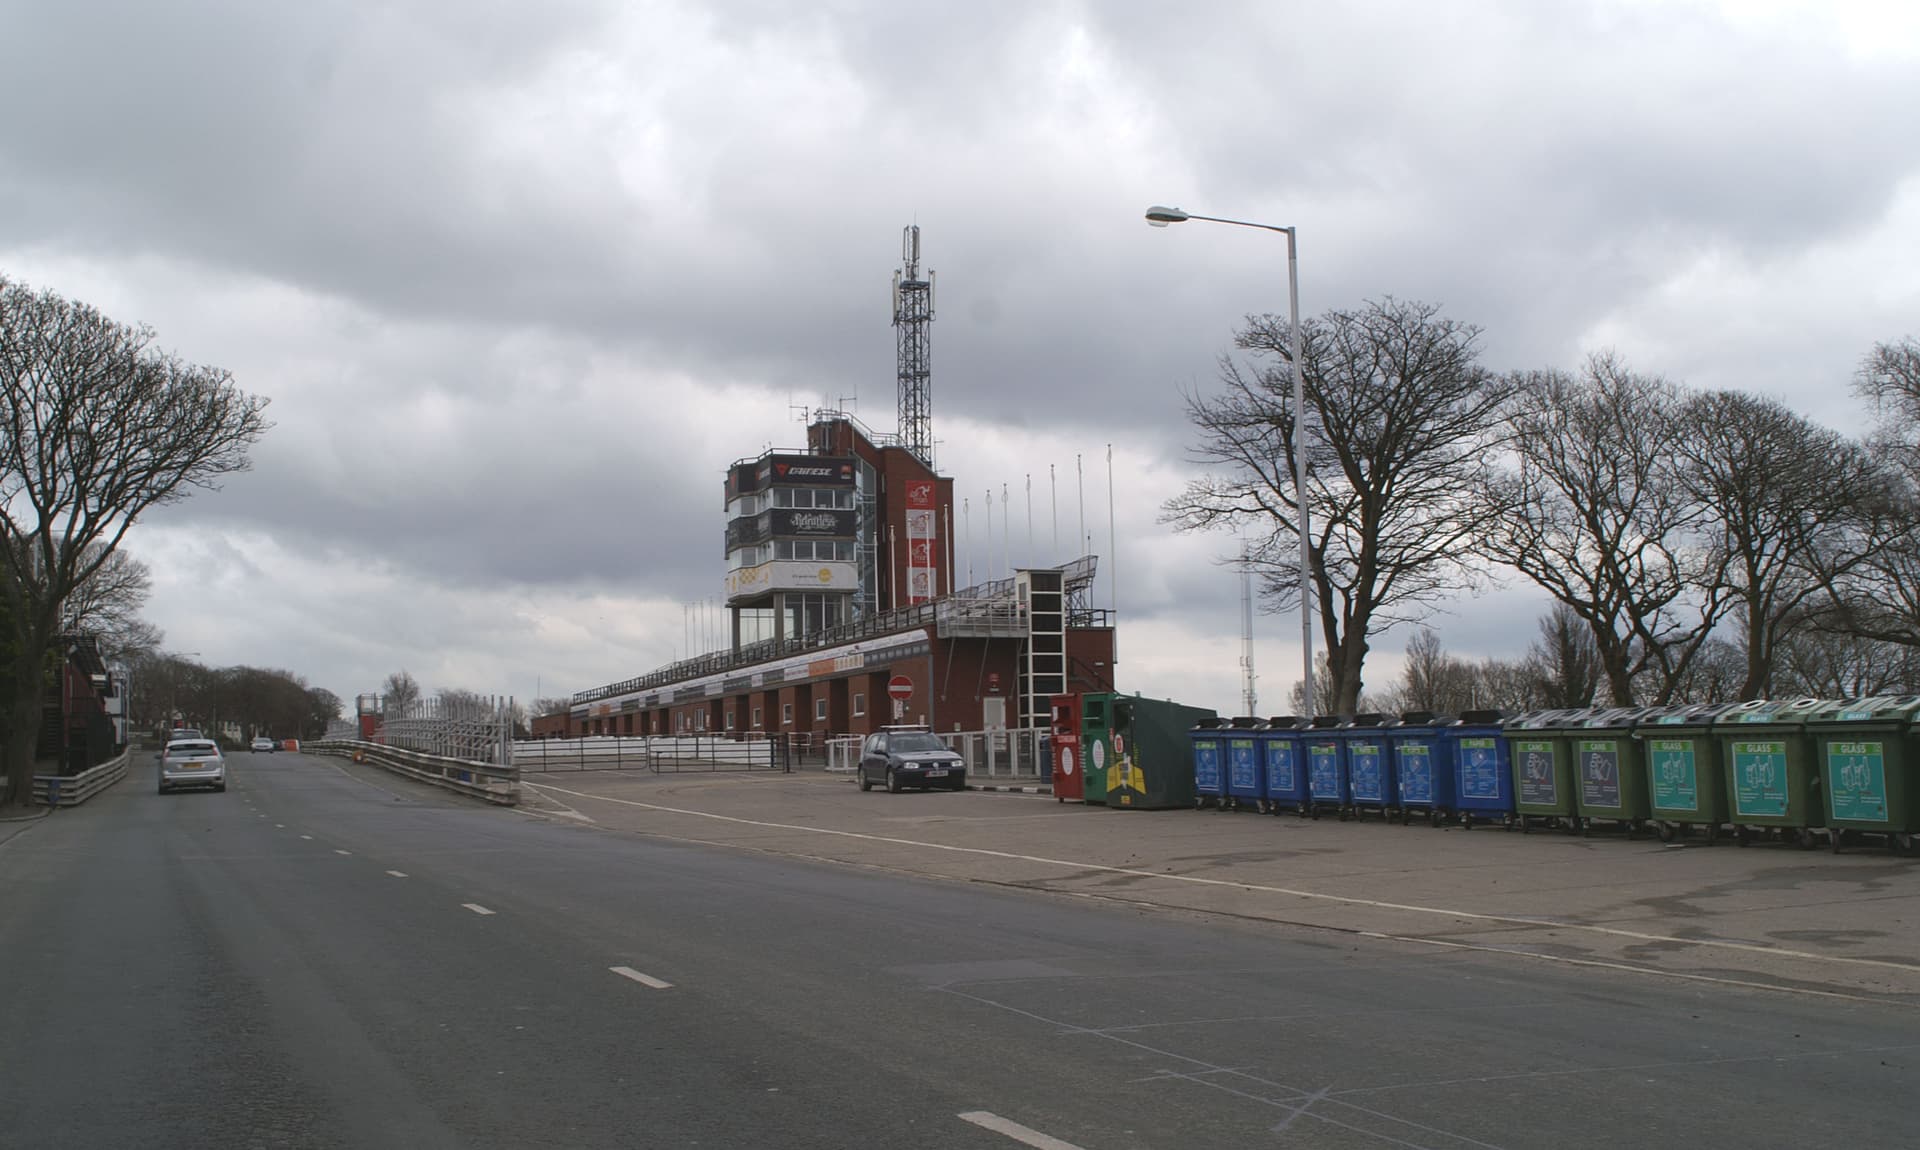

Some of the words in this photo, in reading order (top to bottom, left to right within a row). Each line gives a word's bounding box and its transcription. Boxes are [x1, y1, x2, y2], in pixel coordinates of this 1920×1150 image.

[1663, 741, 1682, 751] GLASS
[1747, 743, 1771, 753] GLASS
[1841, 743, 1867, 754] GLASS
